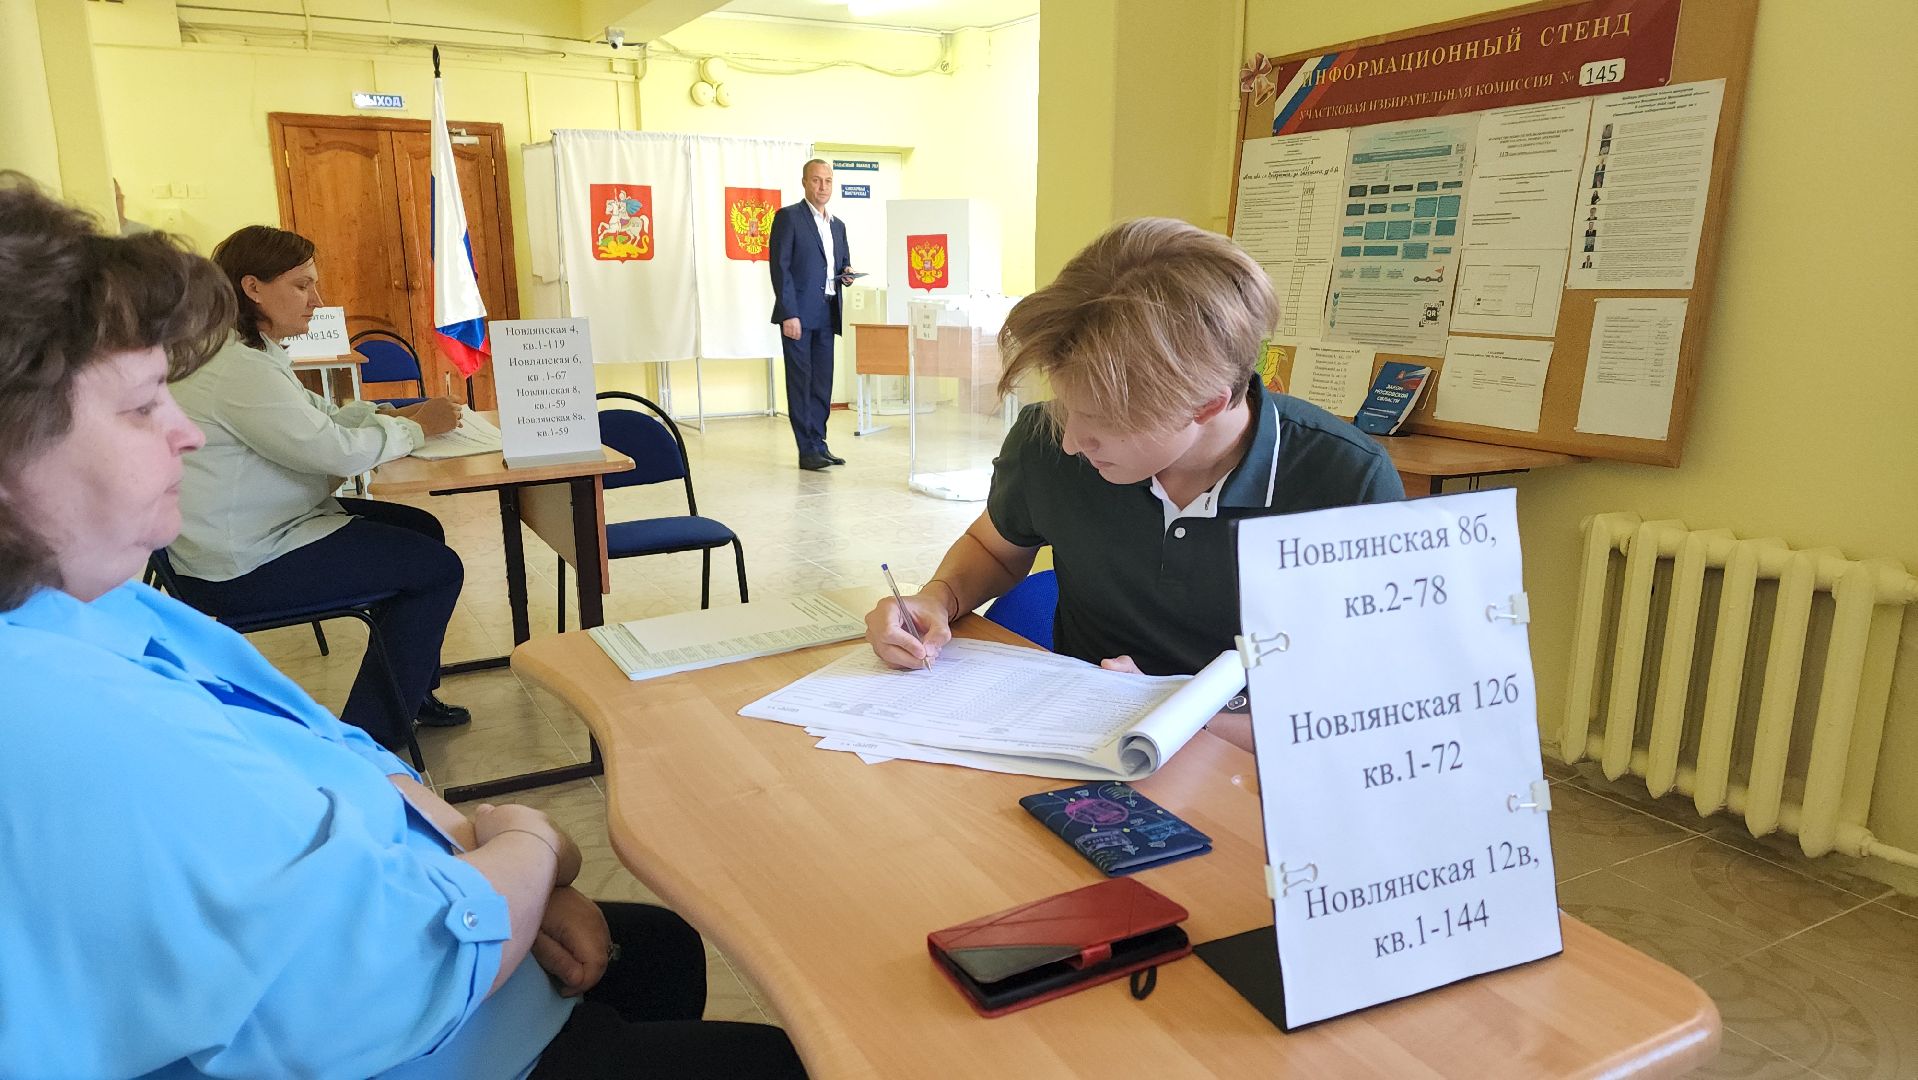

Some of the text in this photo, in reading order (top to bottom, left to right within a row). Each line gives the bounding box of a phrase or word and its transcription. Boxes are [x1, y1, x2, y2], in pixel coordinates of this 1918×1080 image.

[1302, 12, 1632, 88] ИНФОРМАЦИОННЫЙ СТЕНД
[356, 94, 402, 107] ЫХОД
[1299, 102, 1367, 121] УЧАСТКОВАЯ
[1369, 86, 1473, 112] ИЗБИРАТЕЛЬНАЯ
[1476, 73, 1553, 97] КОМИССИЯ
[1586, 64, 1617, 85] 145
[313, 313, 335, 321] тель
[505, 324, 580, 336] Новлянская 4,
[509, 353, 582, 367] Новлянская 6,
[522, 339, 566, 351] кв.1-119
[572, 385, 581, 395] 8,
[1278, 513, 1497, 570] Новлянская 8б,
[1344, 574, 1448, 618] кв.2-78
[1290, 673, 1519, 745] Новлянская 12б
[1363, 740, 1463, 789] кв.1-72
[1305, 841, 1540, 921] Новлянская 12в,
[1375, 898, 1490, 958] кв.1-144
